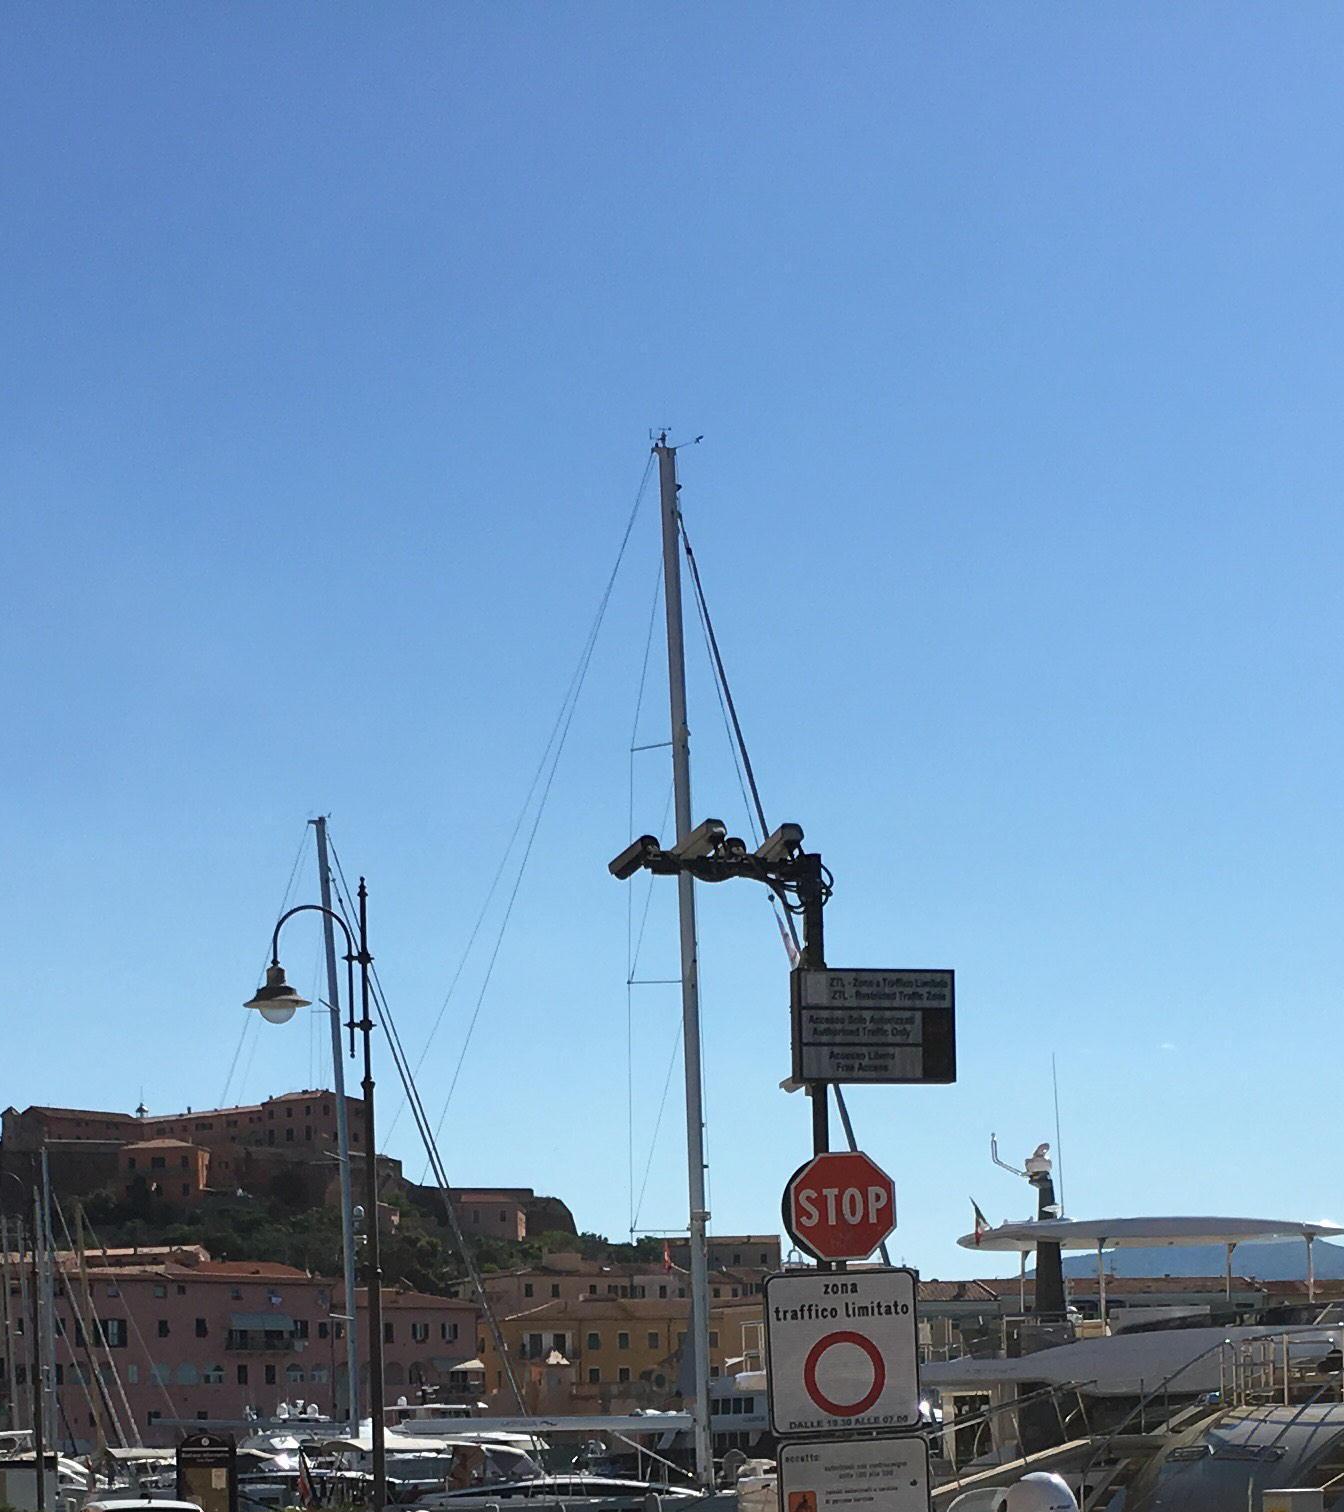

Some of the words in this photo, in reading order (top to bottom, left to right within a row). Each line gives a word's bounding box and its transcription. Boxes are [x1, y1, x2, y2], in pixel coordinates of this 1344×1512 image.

[829, 978, 845, 987] ZTL
[832, 990, 848, 1000] ZTL
[900, 991, 923, 1000] Traffic
[891, 1028, 911, 1039] Only
[836, 1063, 854, 1072] Free
[798, 1186, 888, 1227] STOP
[823, 1281, 858, 1295] zona
[774, 1304, 838, 1321] traffico
[844, 1300, 909, 1318] limitato
[789, 1420, 823, 1430] DALLE
[854, 1417, 880, 1426] ALLE
